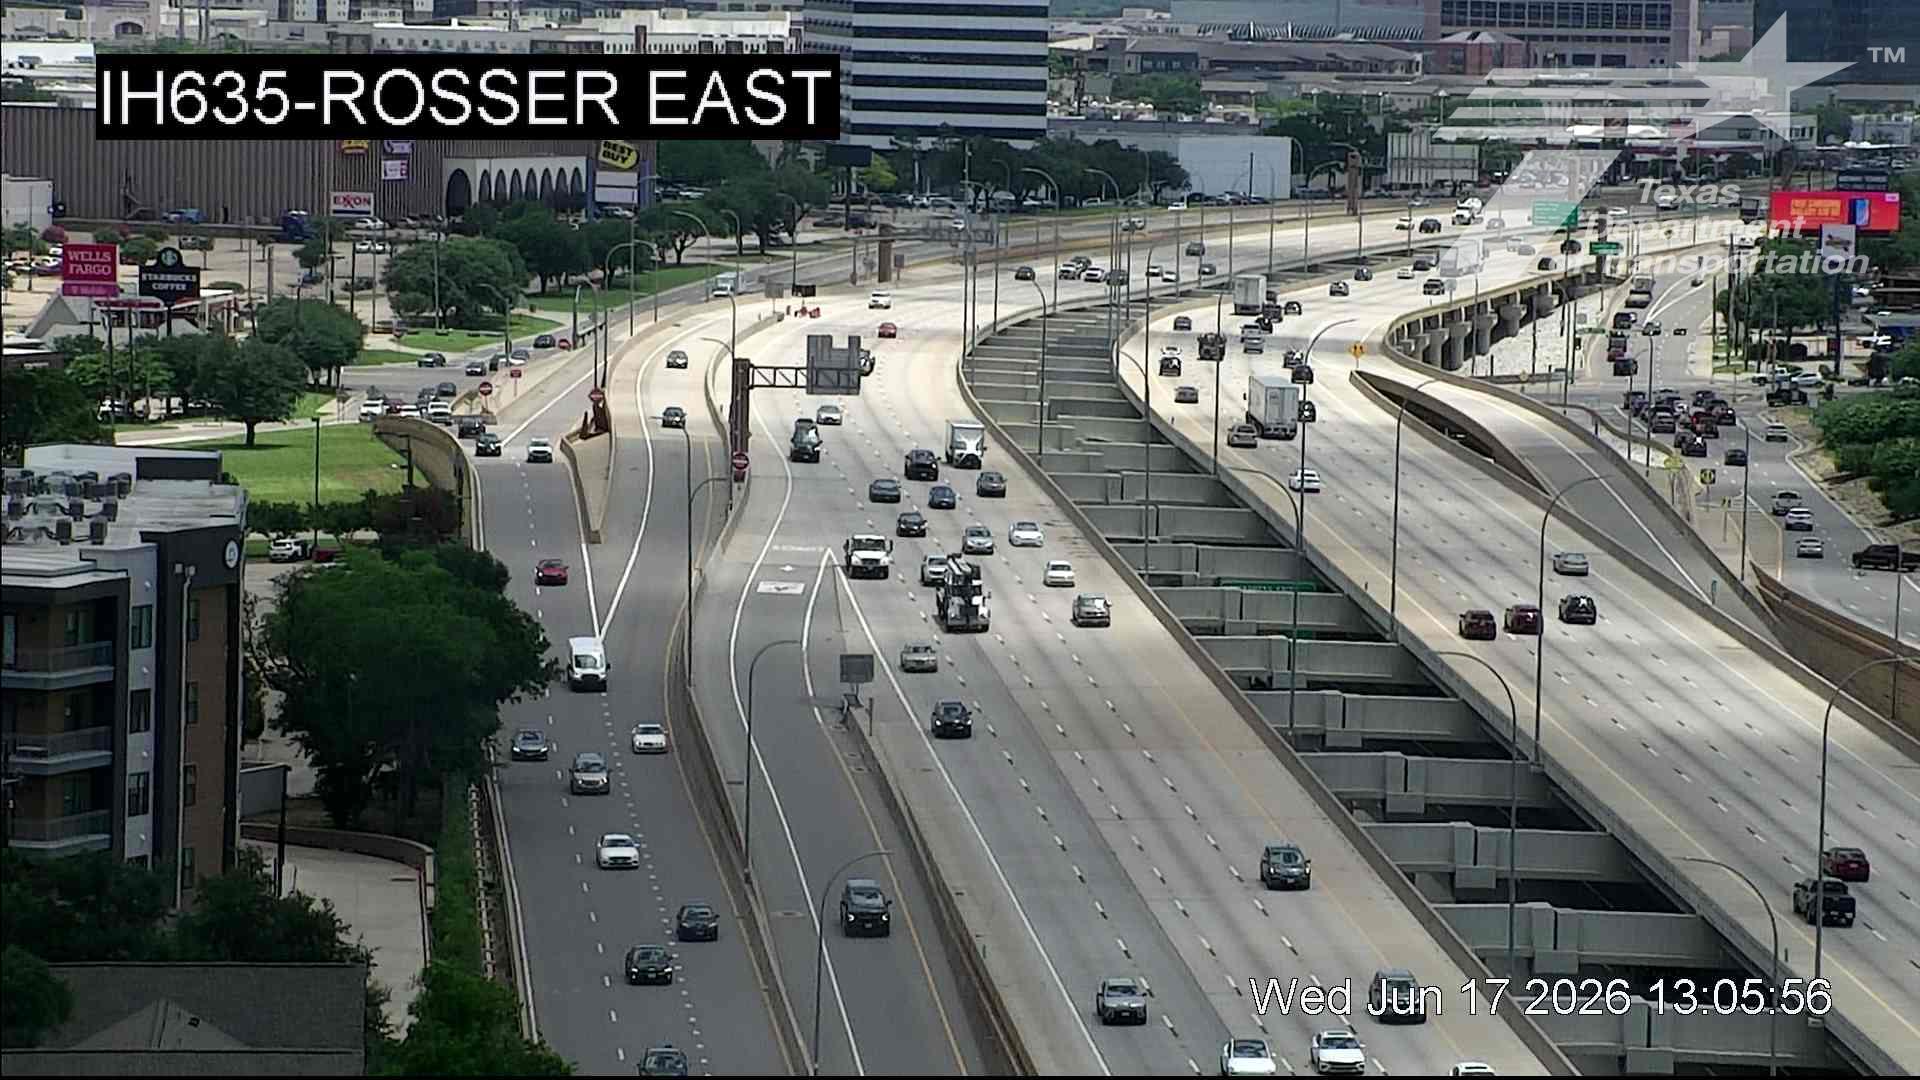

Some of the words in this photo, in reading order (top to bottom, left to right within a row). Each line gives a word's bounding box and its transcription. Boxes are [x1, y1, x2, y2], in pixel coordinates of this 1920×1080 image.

[603, 150, 628, 163] BUY
[68, 250, 111, 261] WELLS
[69, 264, 111, 275] FARGO
